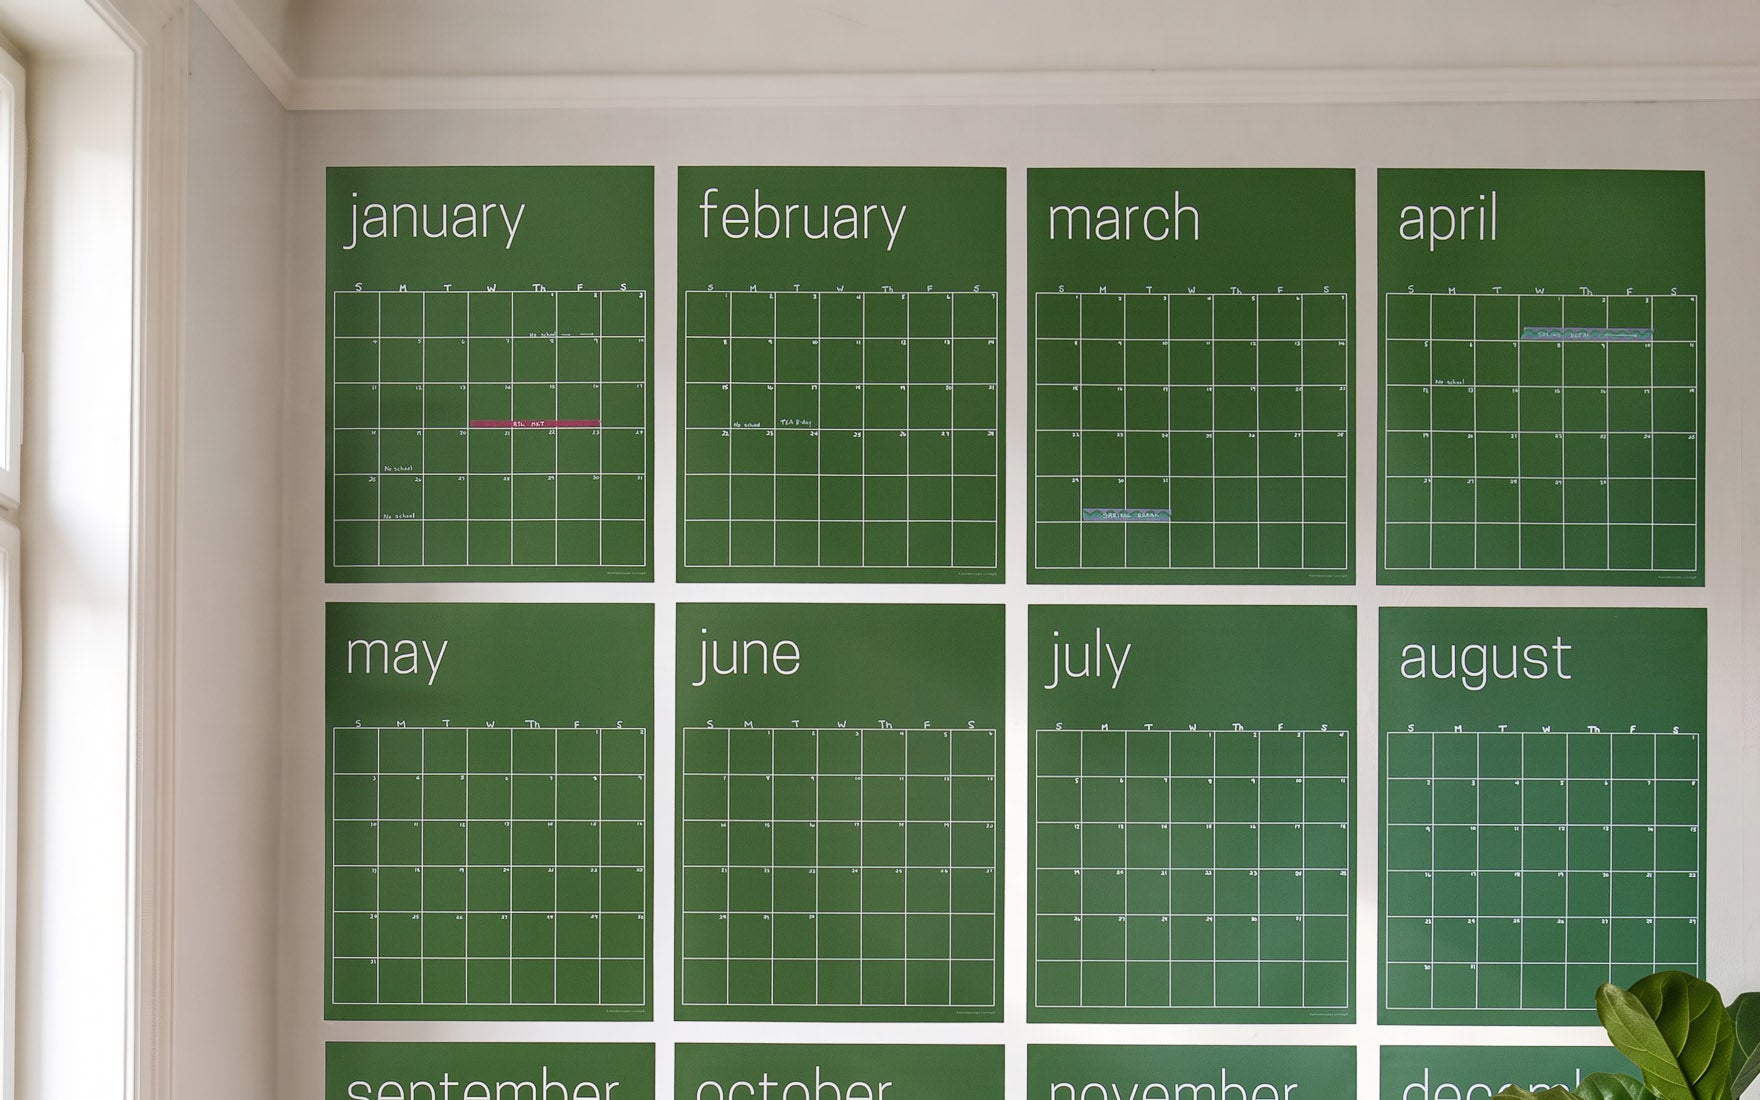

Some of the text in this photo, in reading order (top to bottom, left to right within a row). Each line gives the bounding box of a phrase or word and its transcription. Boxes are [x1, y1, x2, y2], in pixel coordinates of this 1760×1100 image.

[343, 193, 525, 249] january
[700, 188, 906, 250] february
[1050, 191, 1198, 240] march
[1400, 191, 1495, 251] april
[354, 282, 363, 291] S
[486, 283, 497, 291] W
[531, 283, 546, 291] Th
[577, 283, 584, 291] F
[619, 283, 627, 291] S
[707, 283, 714, 291] S
[926, 284, 933, 292] F
[973, 284, 980, 292] S
[1058, 284, 1065, 293] S
[1099, 285, 1107, 293] M
[1145, 285, 1153, 293] T
[1230, 286, 1242, 294] Th
[1277, 286, 1284, 294] F
[1323, 285, 1330, 294] S
[1407, 284, 1415, 294] S
[1491, 286, 1502, 294] T
[1534, 287, 1545, 295] W
[1579, 286, 1593, 295] Th
[1626, 287, 1634, 296] F
[1670, 287, 1677, 296] S
[394, 464, 413, 472] school
[349, 640, 448, 685] may
[692, 629, 799, 686] june
[1045, 628, 1131, 689] july
[1401, 637, 1571, 690] august
[355, 719, 362, 727] S
[441, 719, 450, 727] T
[524, 719, 540, 727] Th
[706, 719, 976, 730] S M T W Th F S
[1055, 722, 1063, 730] S
[1188, 723, 1197, 731] W
[1231, 722, 1244, 731] Th
[1277, 722, 1284, 731] F
[1407, 723, 1415, 732] S
[1454, 724, 1463, 732] M
[1497, 724, 1508, 732] T
[1541, 725, 1551, 733] W
[1587, 725, 1601, 733] Th
[1629, 724, 1637, 733] F
